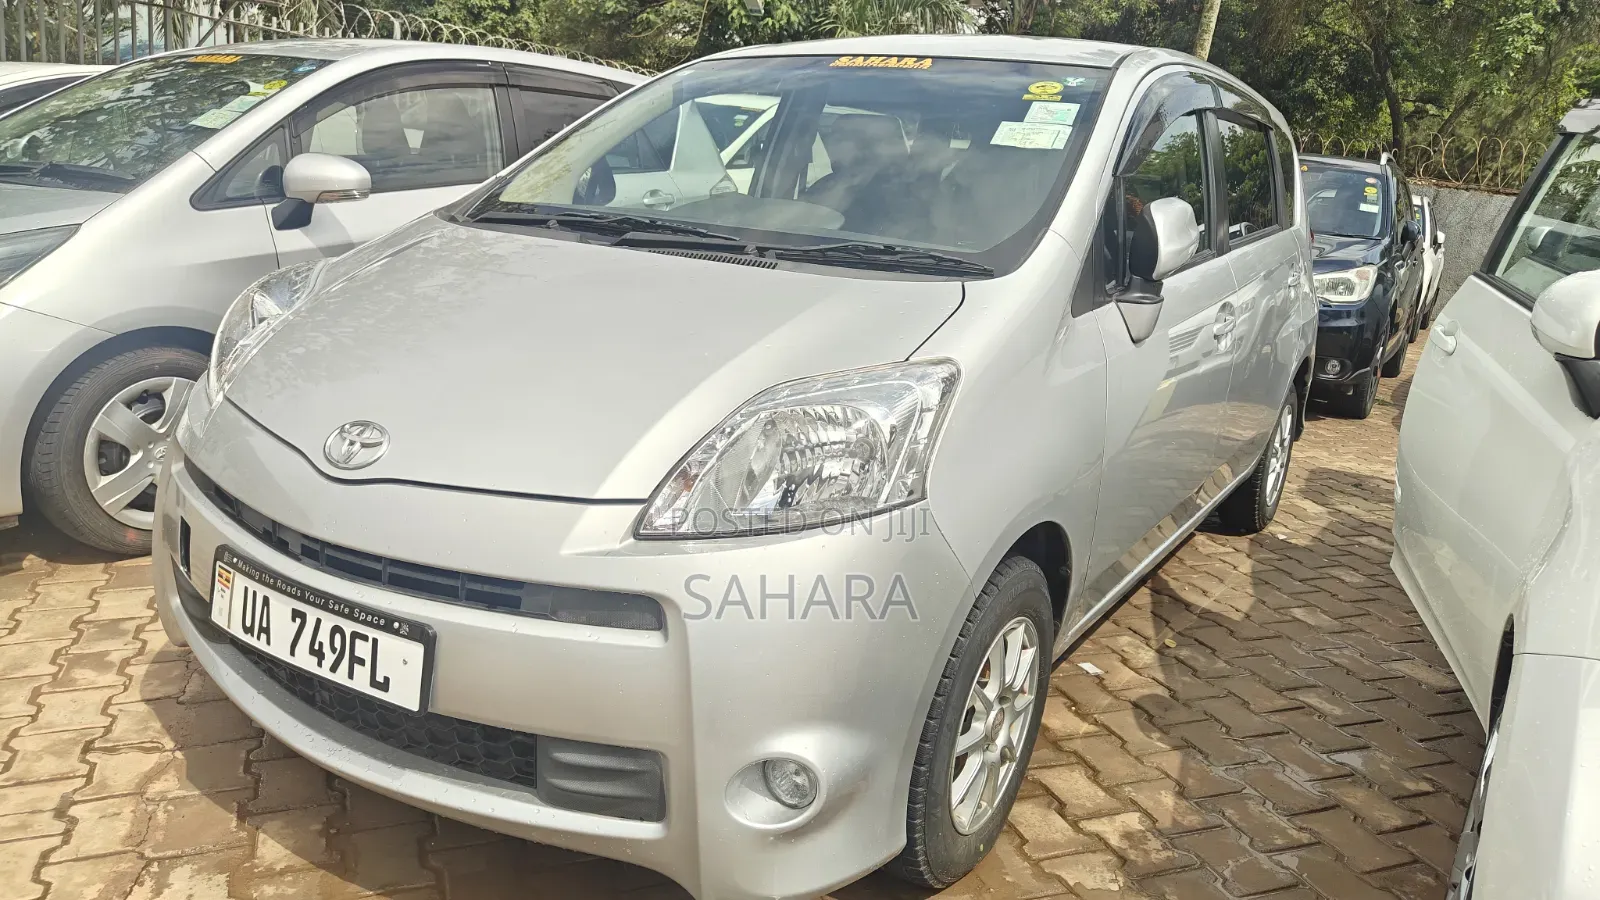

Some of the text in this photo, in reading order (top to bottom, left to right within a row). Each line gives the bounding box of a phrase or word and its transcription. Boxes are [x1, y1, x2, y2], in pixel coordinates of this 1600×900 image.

[835, 56, 932, 67] SAHARA
[237, 560, 260, 580] Making
[262, 572, 274, 586] the
[276, 579, 302, 597] Roads
[305, 591, 325, 606] Your
[328, 600, 350, 615] Safe
[354, 608, 386, 626] Space
[241, 585, 391, 693] UA 749FL
